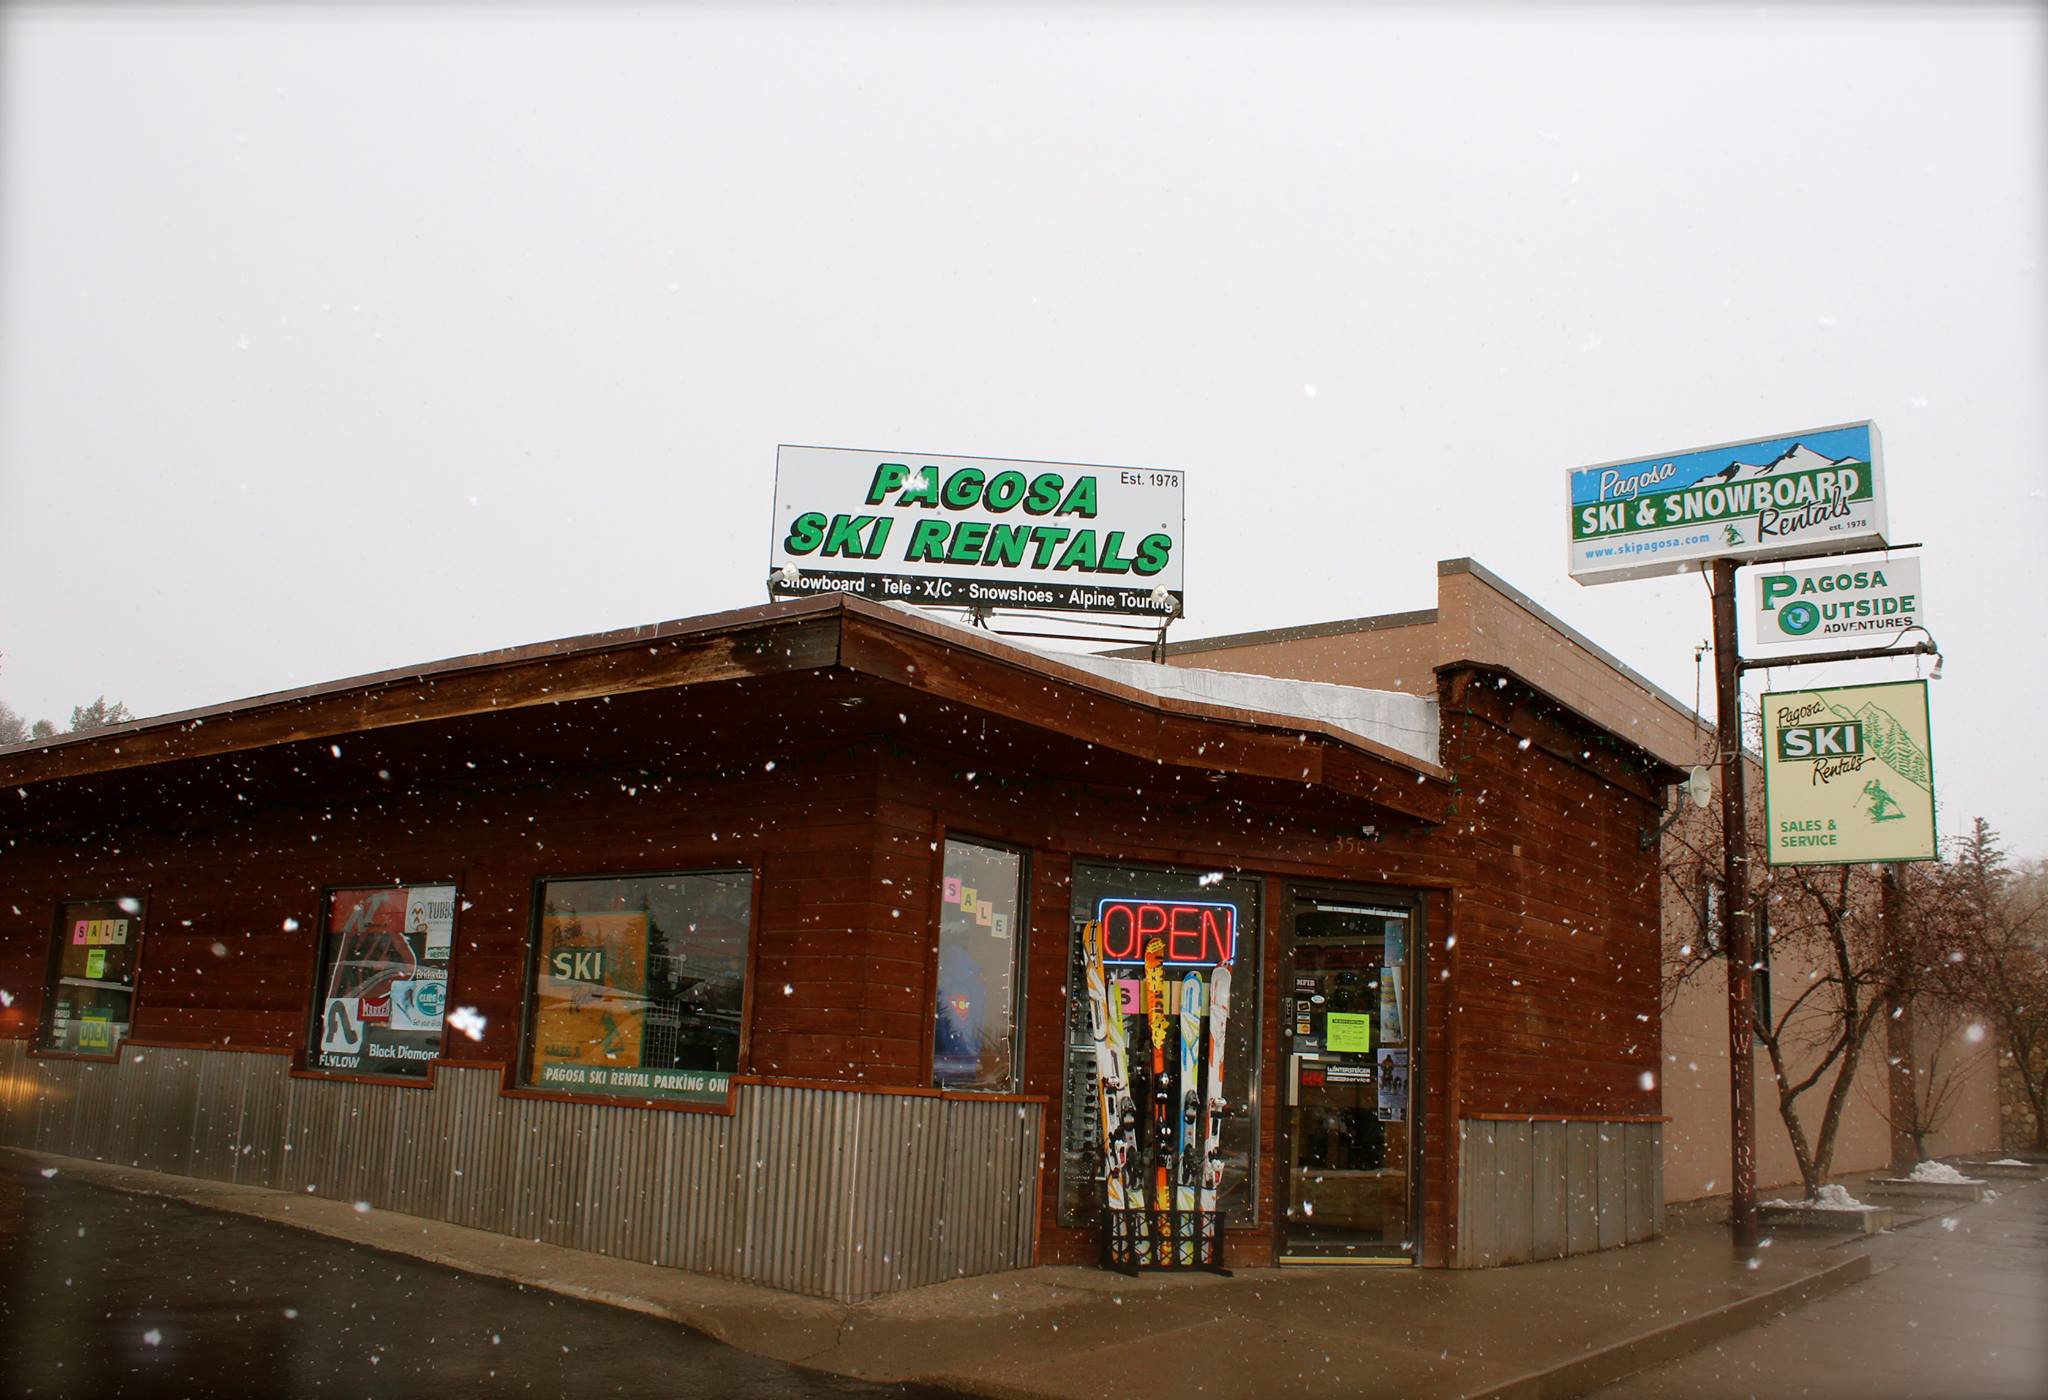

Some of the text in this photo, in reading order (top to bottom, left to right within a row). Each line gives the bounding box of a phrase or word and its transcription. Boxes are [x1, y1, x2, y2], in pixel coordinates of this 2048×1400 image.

[865, 463, 1098, 518] PAGOSA
[1120, 472, 1179, 488] Est. 1978
[1600, 462, 1677, 501] Pagosa
[1582, 468, 1860, 534] SKI & SNOWBOARD
[1758, 484, 1851, 543] Rentals
[1828, 519, 1867, 532] est. 1978
[784, 512, 1172, 577] SKI RENTALS
[1585, 533, 1710, 560] www.skipagosa.com
[780, 575, 865, 592] Snowboard
[882, 578, 911, 594] Tele
[924, 578, 952, 597] X/C
[969, 583, 1054, 603] Snowshoes
[1068, 589, 1115, 609] Alpine
[1761, 570, 1888, 611] PAGOSA
[1777, 595, 1916, 636] OUTSIDE
[1823, 616, 1913, 634] ADVENTURES
[1777, 701, 1825, 728] Pagosa
[1785, 726, 1857, 757] SKI
[1812, 756, 1876, 786] Rentals
[1780, 819, 1837, 832] SALES &
[1781, 834, 1837, 848] SERVICE
[947, 882, 1004, 932] SALE
[78, 923, 124, 938] SALE
[1103, 905, 1233, 962] OPEN
[554, 952, 602, 980] SKI
[319, 1054, 360, 1068] FLYLOW
[369, 1043, 396, 1059] Black
[546, 1068, 585, 1084] PAGOSA
[589, 1072, 607, 1085] SKI
[611, 1073, 650, 1088] RENTAL
[654, 1074, 704, 1092] PARKING
